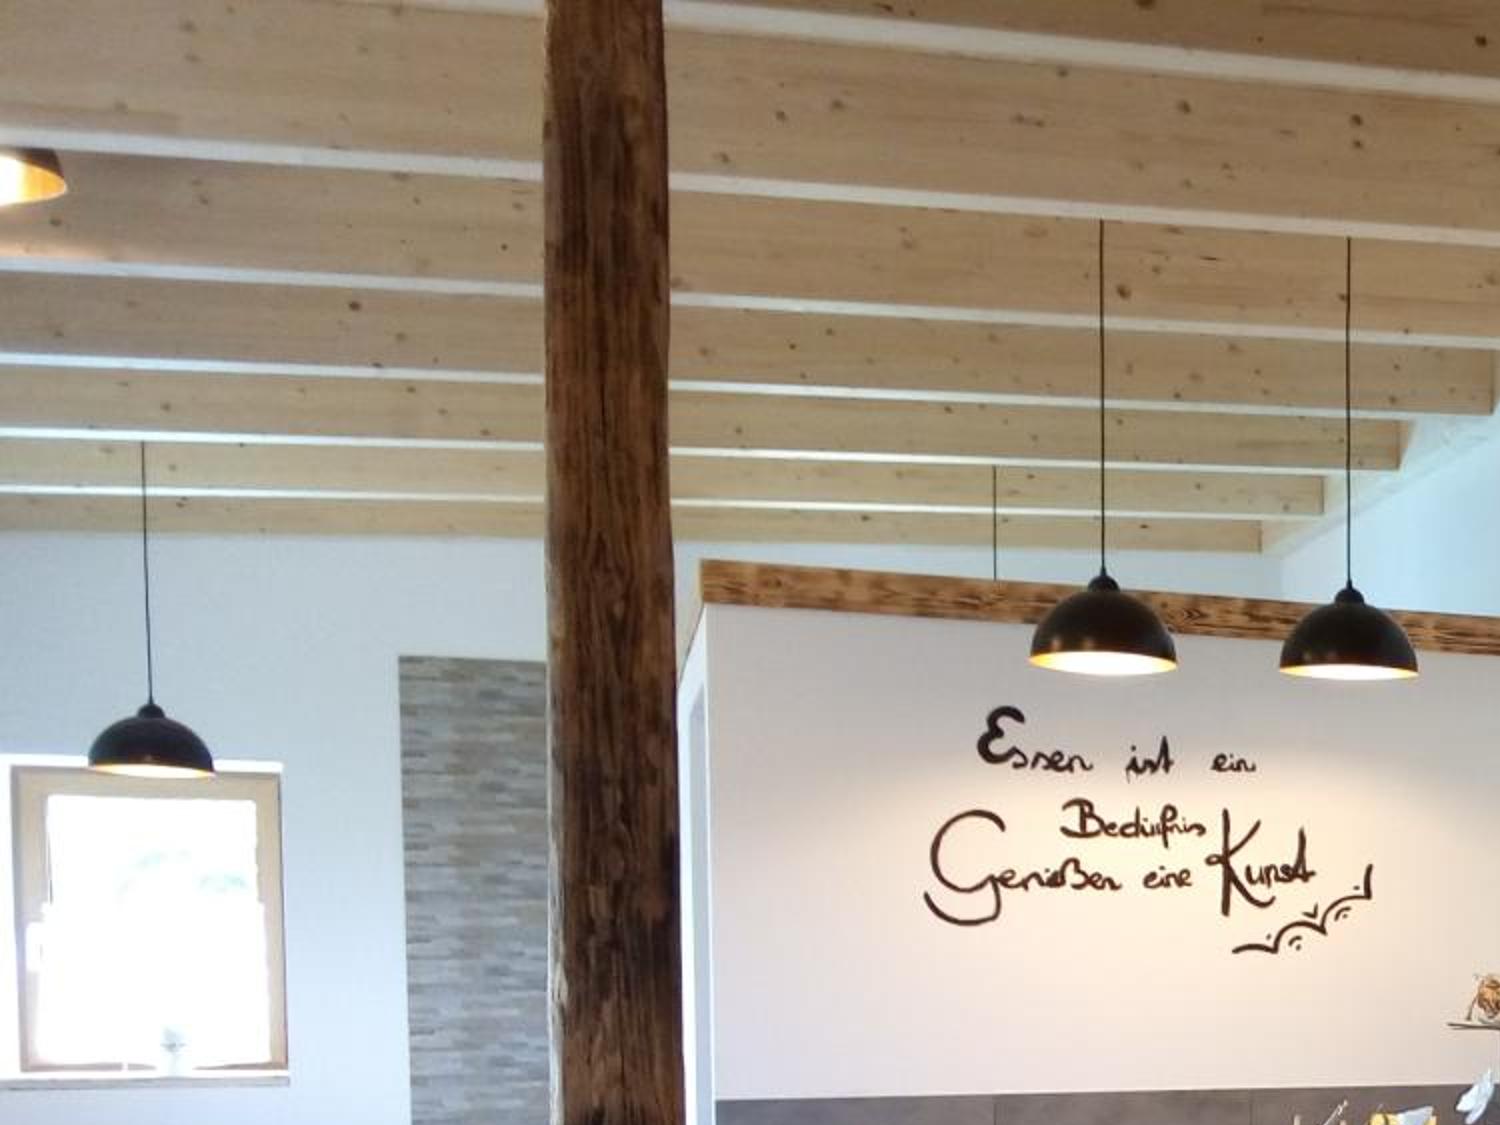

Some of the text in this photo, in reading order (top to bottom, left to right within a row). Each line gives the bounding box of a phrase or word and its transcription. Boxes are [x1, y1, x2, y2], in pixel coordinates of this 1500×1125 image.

[977, 705, 1256, 782] Essen ist ein
[1143, 866, 1193, 889] eine
[1205, 808, 1316, 917] Kunst
